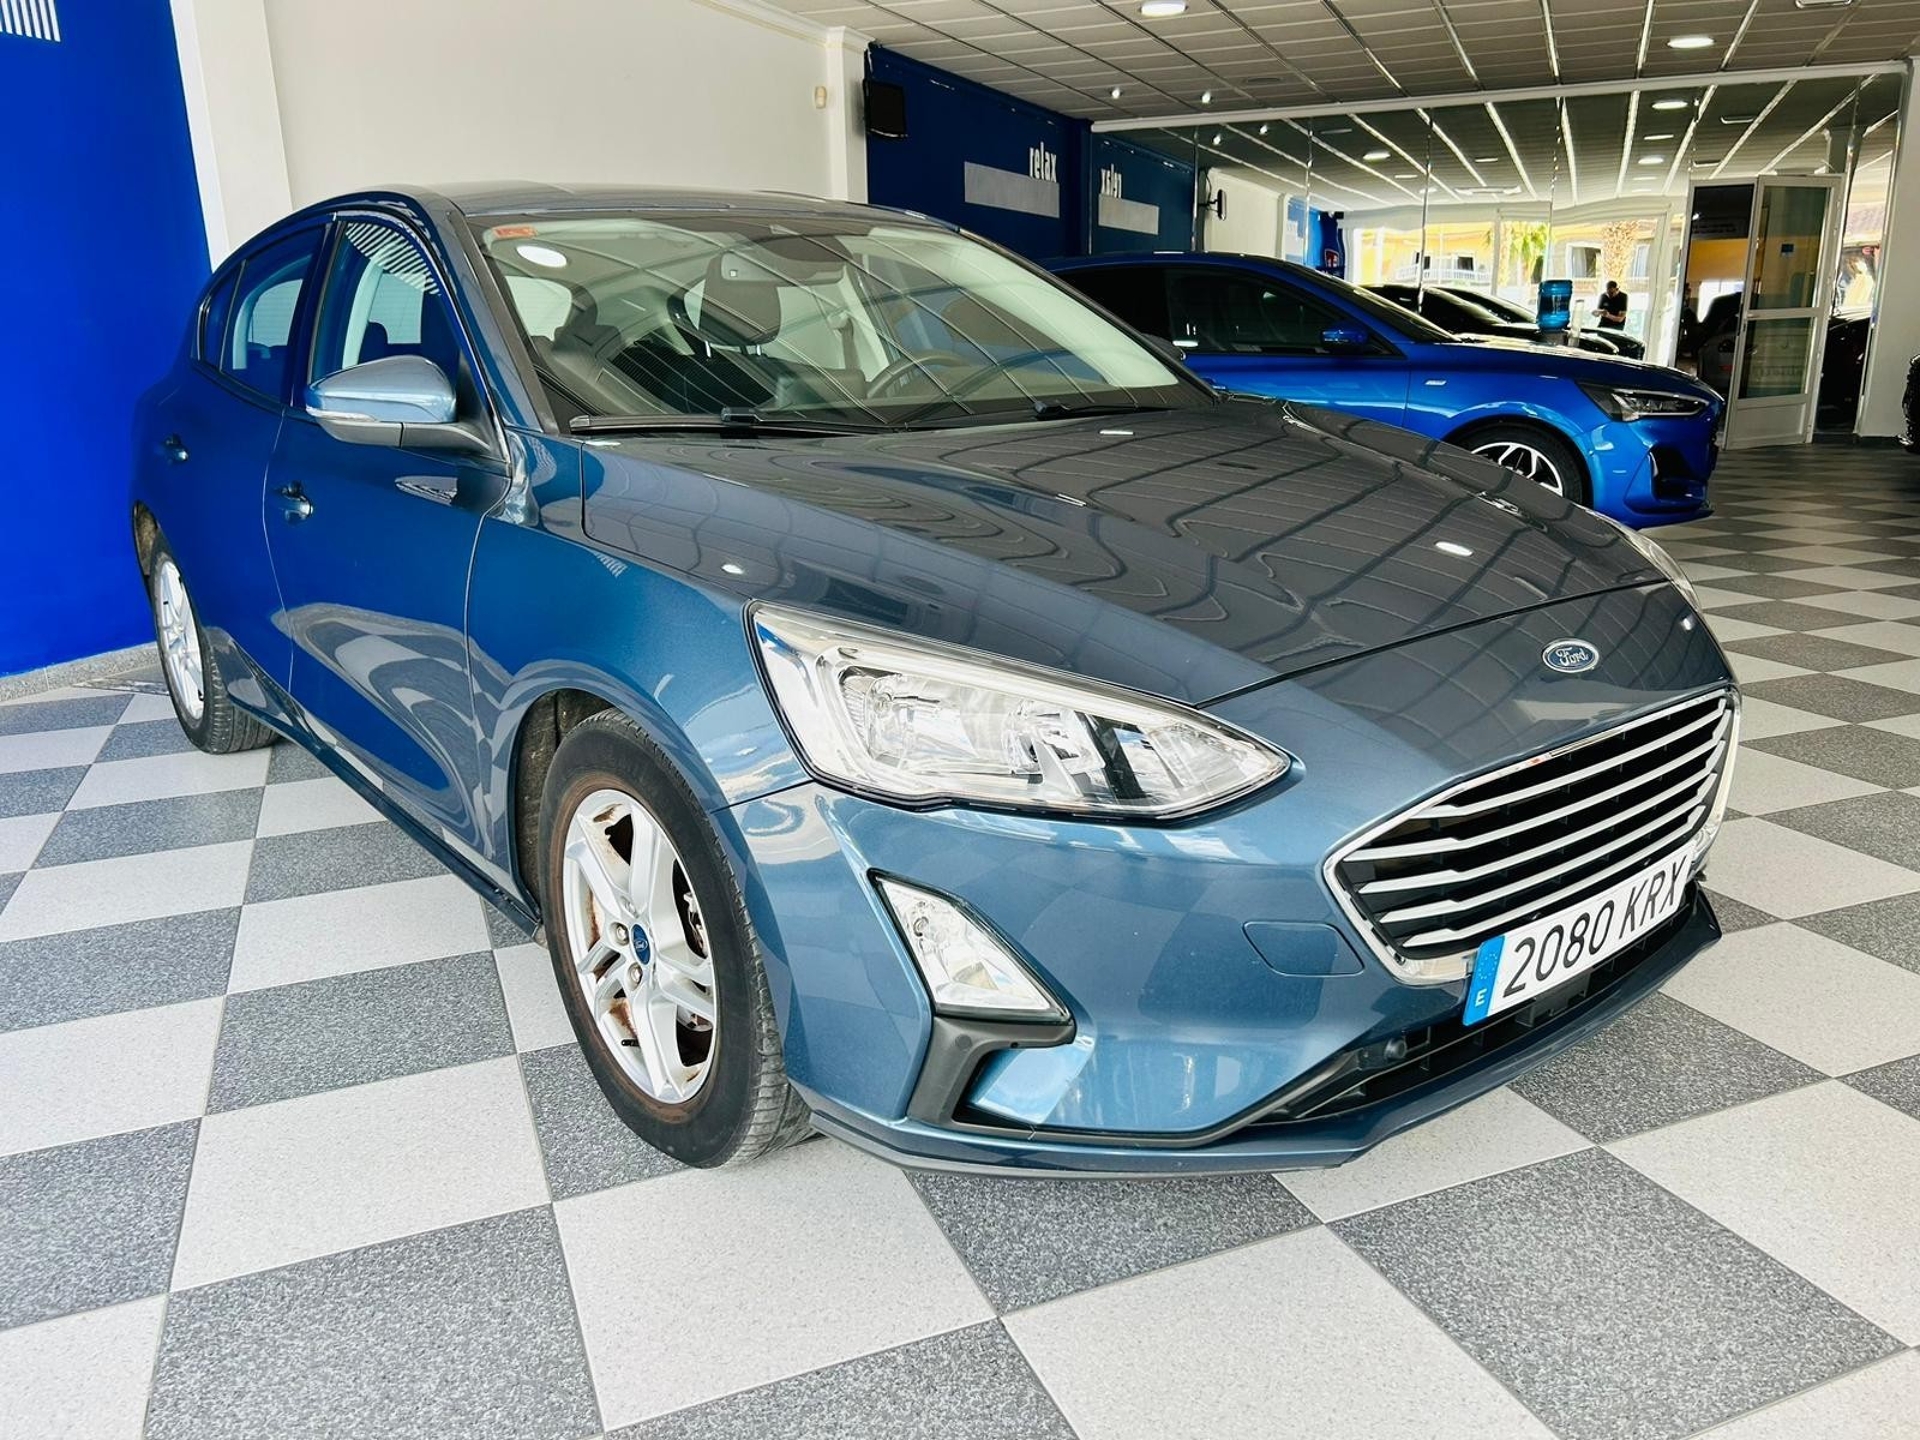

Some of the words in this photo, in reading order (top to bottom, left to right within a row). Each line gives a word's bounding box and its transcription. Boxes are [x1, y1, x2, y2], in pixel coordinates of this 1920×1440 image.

[1029, 141, 1057, 183] relax
[1555, 646, 1590, 666] Ford
[1502, 899, 1615, 998] 2080
[1618, 854, 1688, 940] KRX
[1474, 987, 1488, 1008] E
